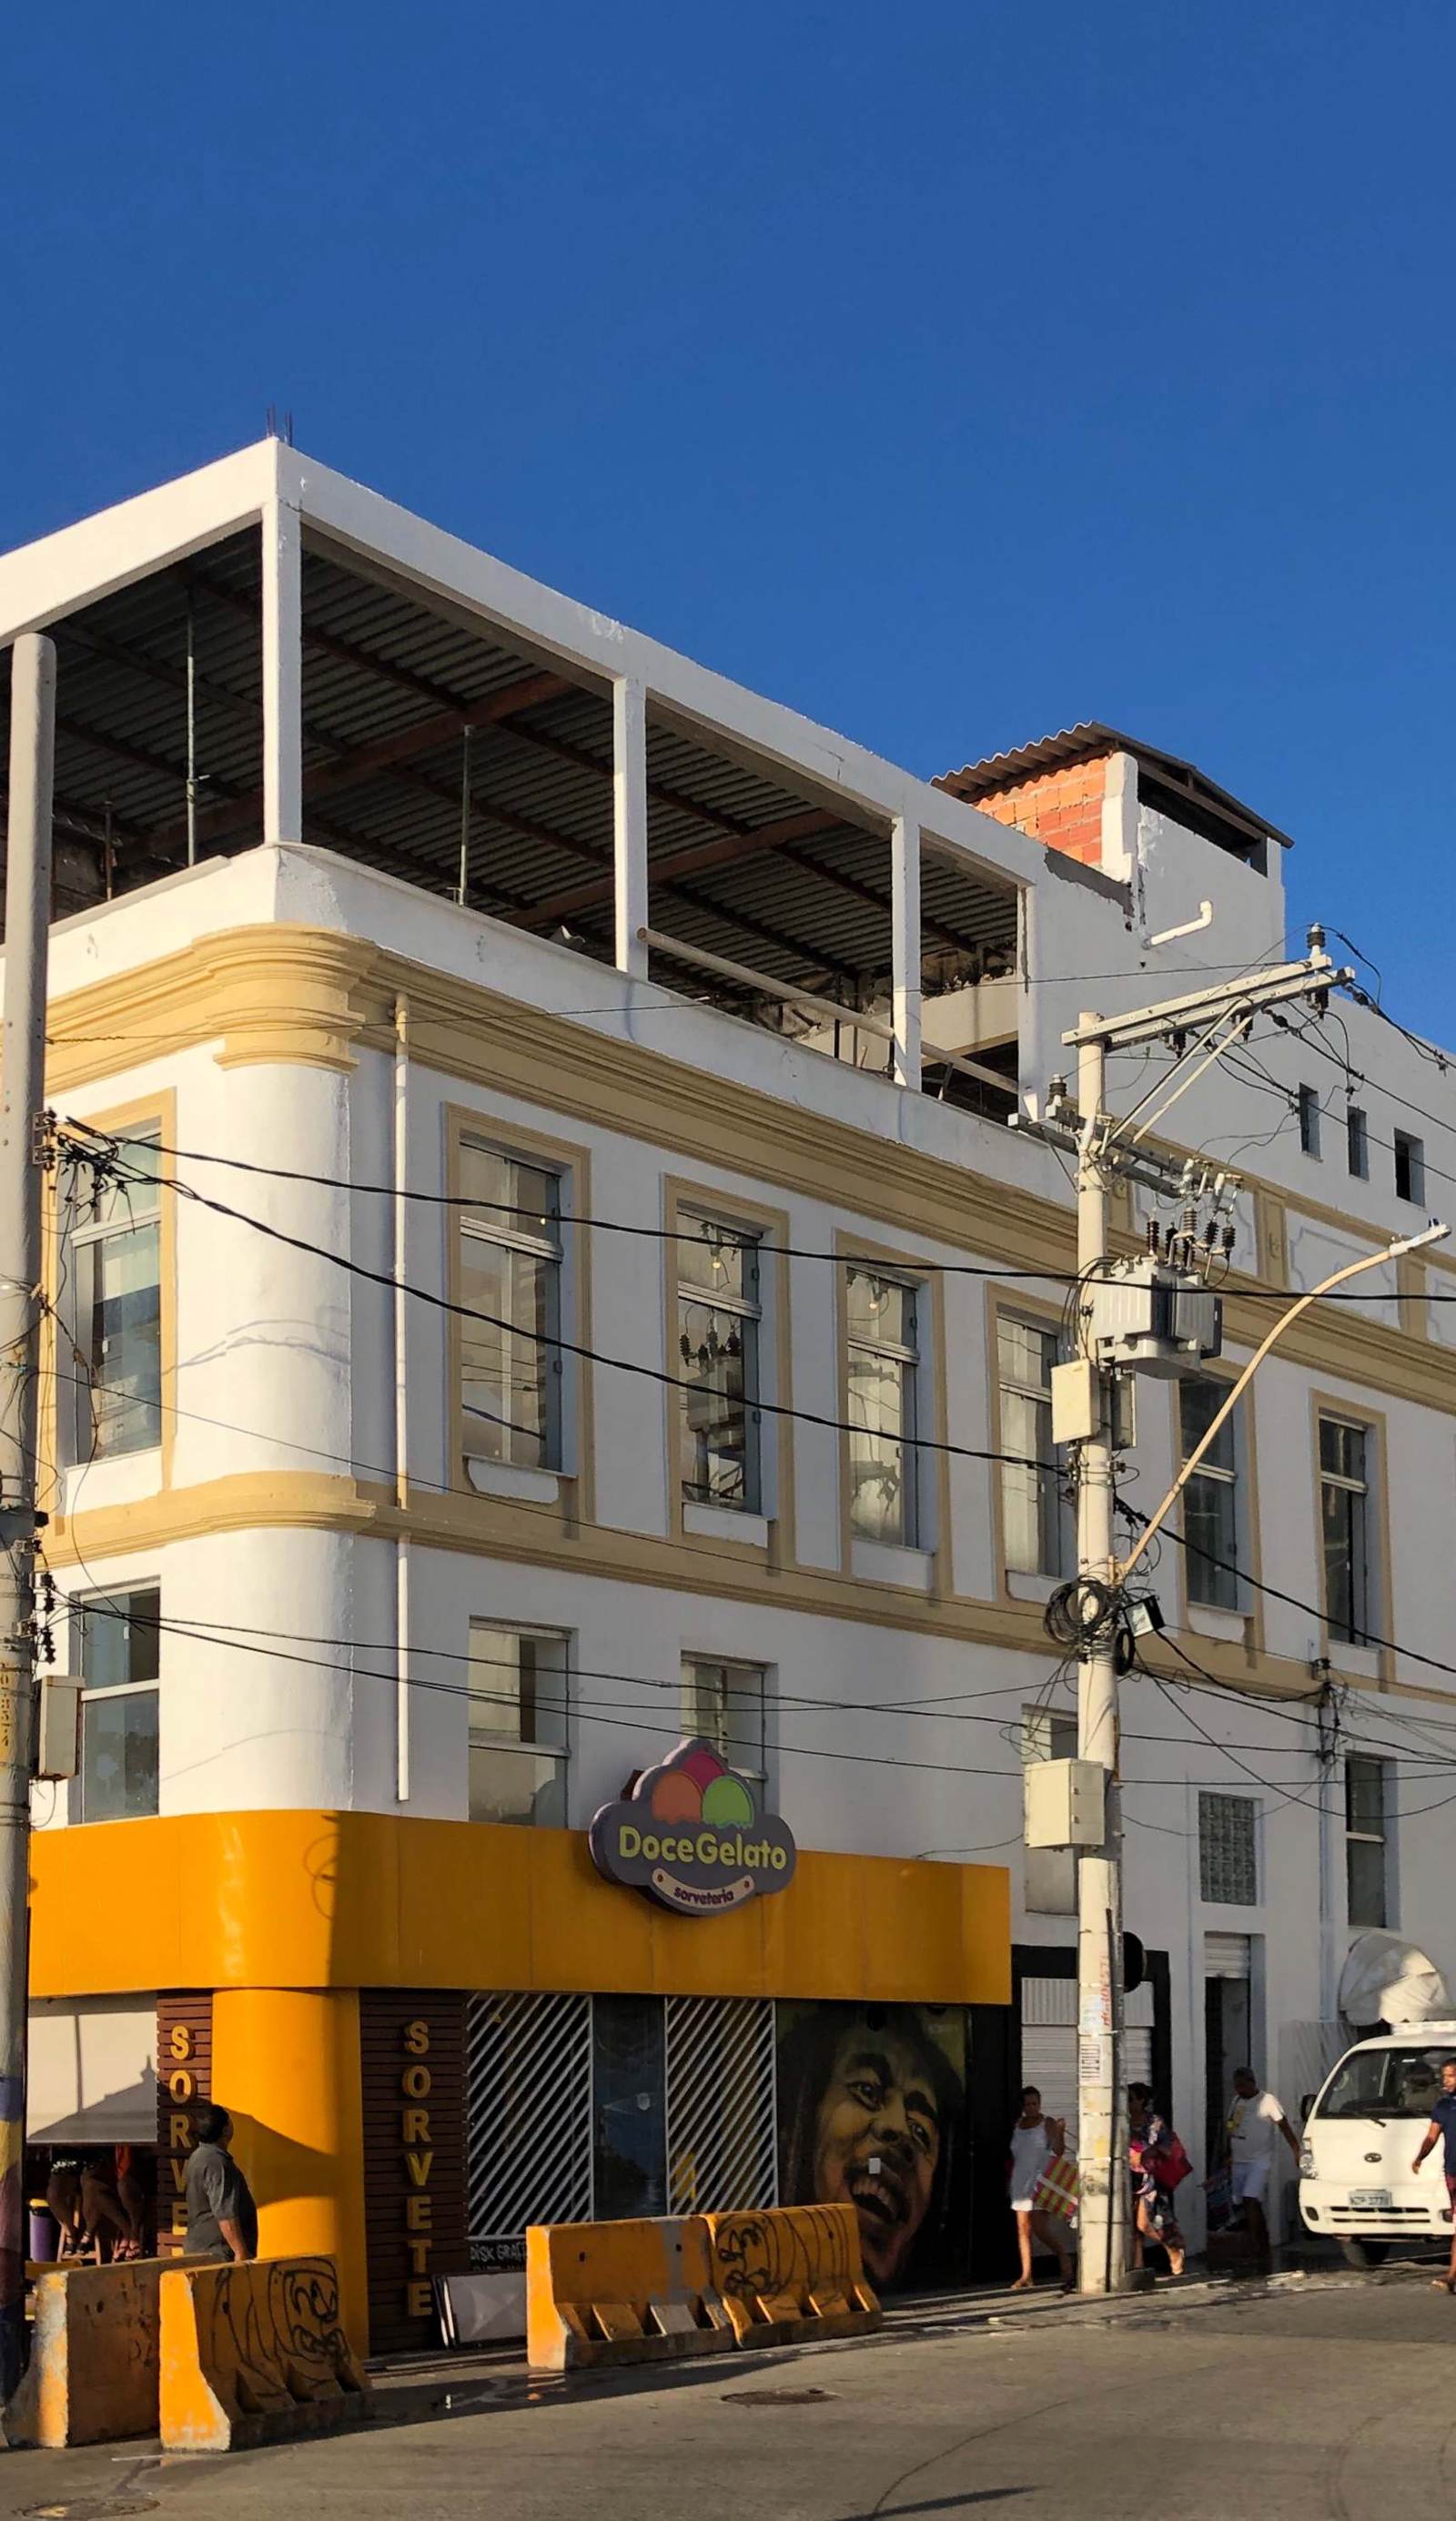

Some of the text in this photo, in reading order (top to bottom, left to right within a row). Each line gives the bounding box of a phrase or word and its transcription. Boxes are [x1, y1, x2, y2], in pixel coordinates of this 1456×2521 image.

[619, 1825, 787, 1870] DoceGelato
[673, 1887, 734, 1906] sorveteria
[402, 2020, 434, 2317] SORVETE
